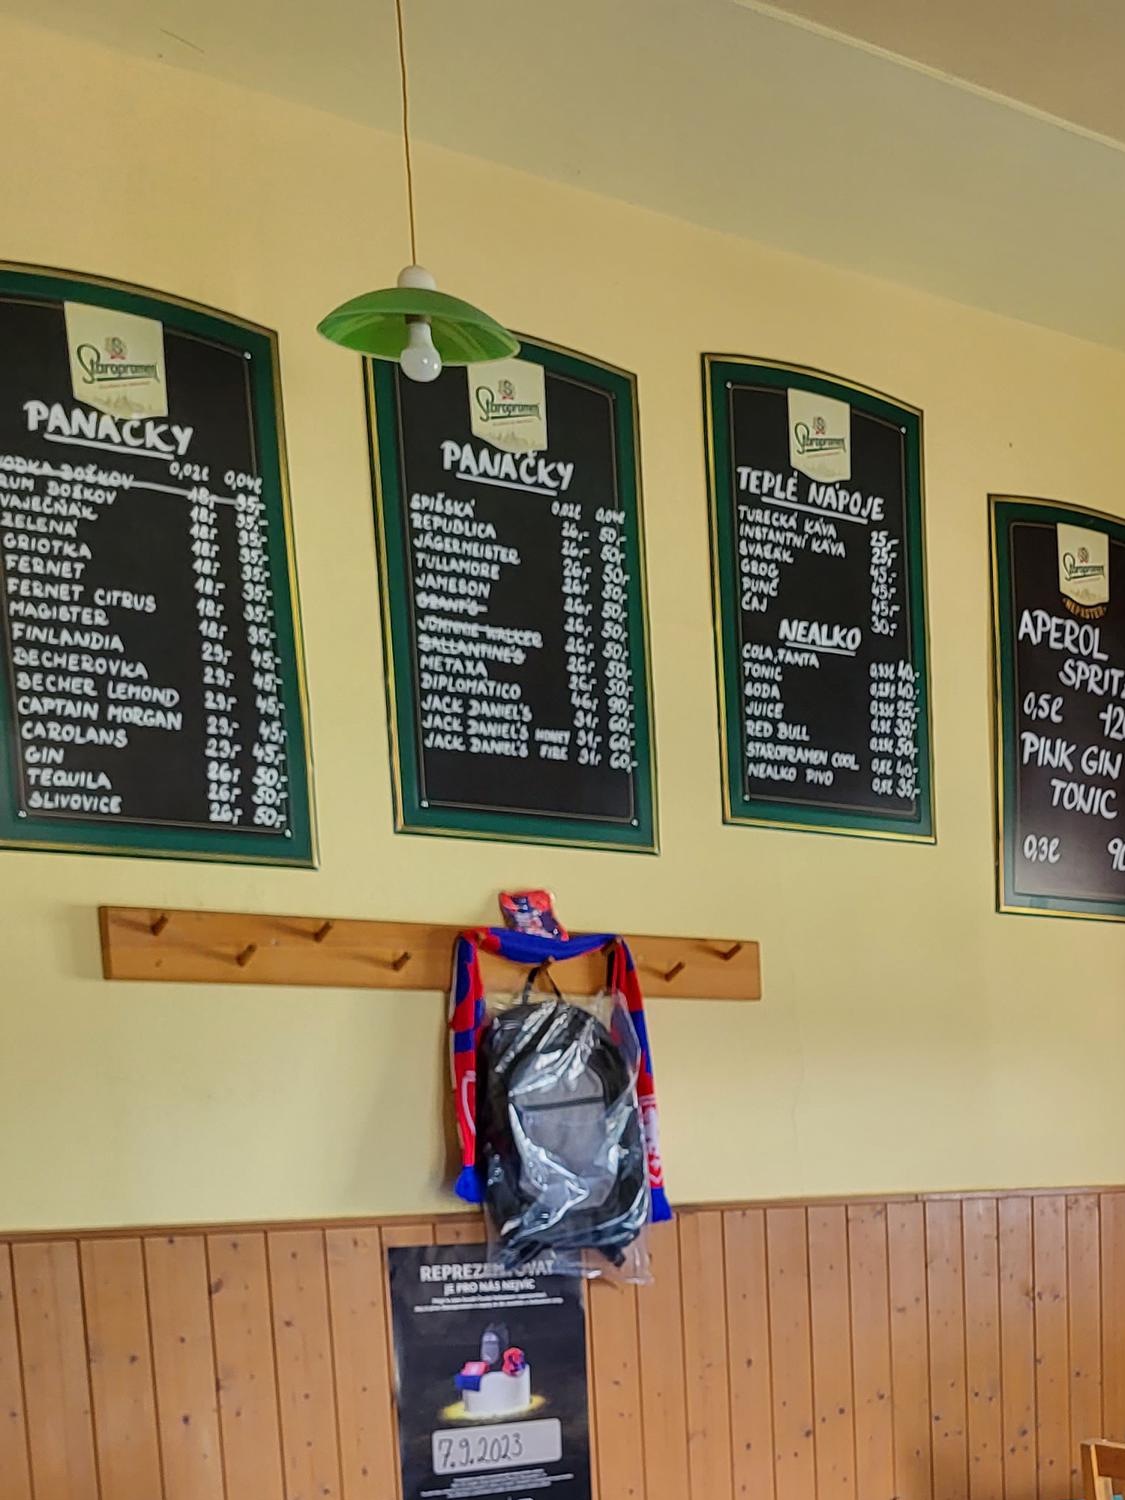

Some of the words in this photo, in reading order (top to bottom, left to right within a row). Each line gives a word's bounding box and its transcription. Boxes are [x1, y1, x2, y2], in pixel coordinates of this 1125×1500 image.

[736, 466, 798, 501] TEPLÉ
[808, 482, 884, 521] NÁPOJE
[804, 518, 837, 539] KÁVA
[3, 532, 92, 560] GRIOTKA
[811, 537, 846, 559] KÁVA
[5, 554, 85, 579] FERNET
[740, 558, 779, 578] GROG
[7, 577, 84, 602] FERNET
[94, 589, 156, 613] CITRUS
[415, 573, 490, 598] JAMESON
[9, 601, 109, 626] MAGISTER
[12, 622, 124, 653] FINLANDIA
[778, 619, 862, 651] NEALKO
[1017, 608, 1108, 661] APEROL
[13, 646, 148, 680] BECHEROVKA
[420, 654, 488, 677] METAXA
[742, 661, 783, 682] TONIC
[17, 671, 98, 696] BECHER
[107, 680, 179, 707] LEMOND
[744, 682, 781, 700] SODA
[18, 696, 98, 720] CAPTAIN
[107, 706, 182, 731] MORGAN
[421, 694, 464, 714] JACK
[745, 702, 784, 719] JUICE
[21, 720, 128, 748] CAROLANS
[422, 713, 463, 732] JACK
[745, 720, 773, 738] RED
[776, 722, 810, 742] BULL
[424, 731, 466, 752] JACK
[25, 745, 64, 765] GIN
[1020, 731, 1074, 774] PINK
[1080, 745, 1122, 780] GIN
[27, 767, 112, 790] TEQUILA
[748, 762, 797, 782] NEALKO
[806, 769, 834, 785] PIVO
[28, 791, 122, 814] SLIVOVICE
[1049, 777, 1118, 820] TONIC
